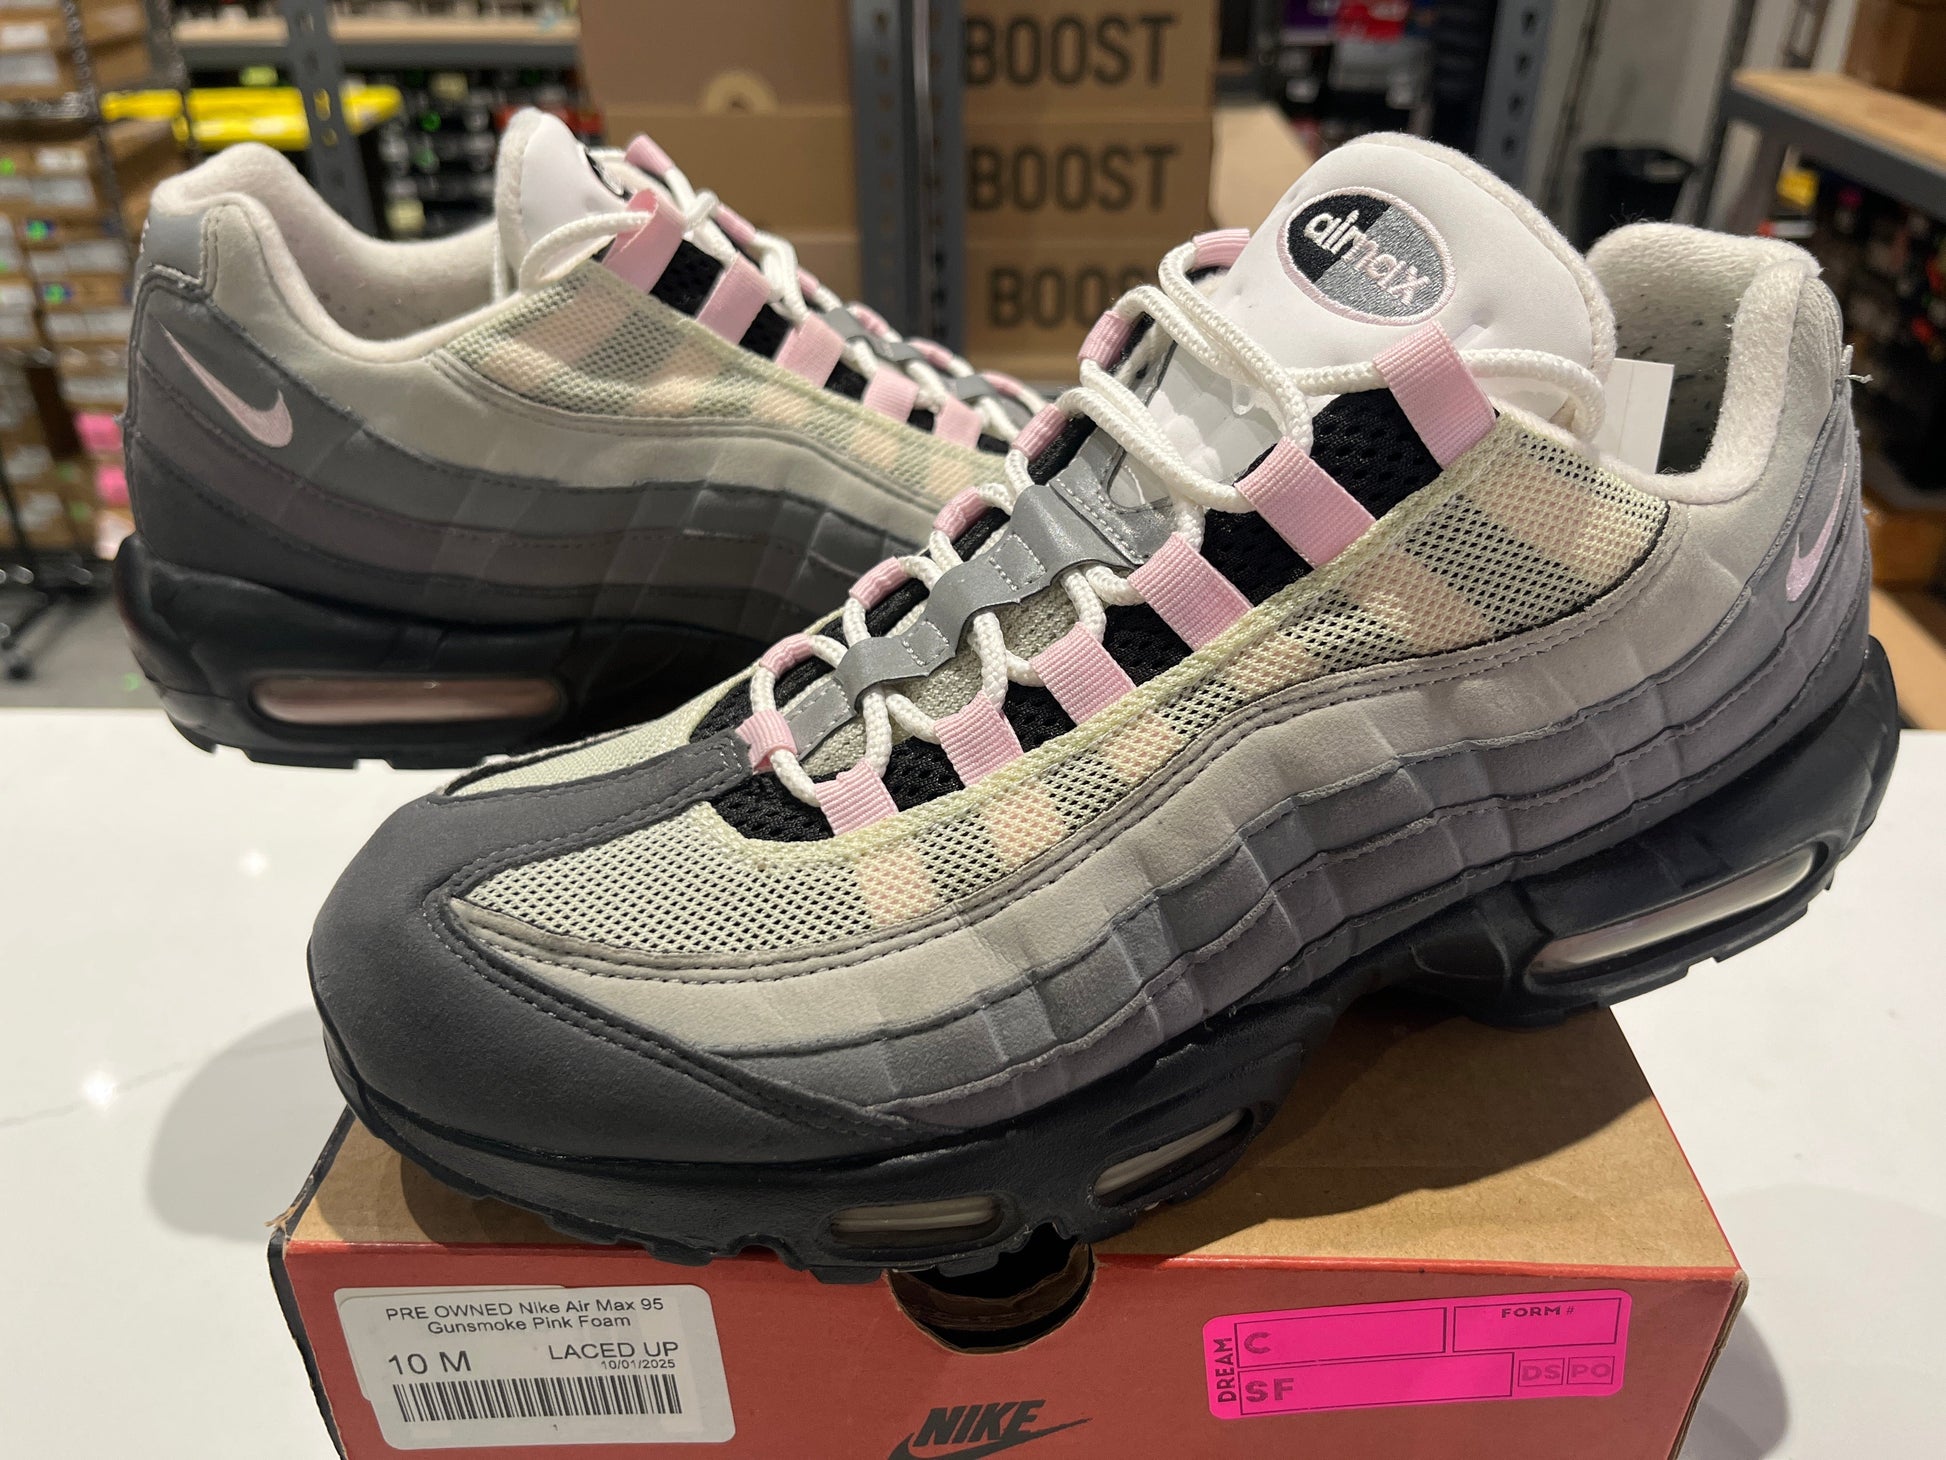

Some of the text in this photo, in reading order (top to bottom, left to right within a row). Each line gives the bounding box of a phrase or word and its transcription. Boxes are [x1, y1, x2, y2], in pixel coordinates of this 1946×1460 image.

[963, 14, 1178, 87] BOOST
[968, 144, 1178, 213] BOOST
[386, 1298, 664, 1321] PRE OWNED Nike Air Max 95
[1501, 1305, 1575, 1319] FORM #
[428, 1315, 631, 1334] Gunsmoke Pink Foam
[548, 1341, 679, 1360] LACED UP
[1244, 1331, 1271, 1354] C
[388, 1350, 471, 1375] 10 M
[601, 1358, 676, 1370] 10/01/2025
[1213, 1337, 1237, 1403] DREAM
[1521, 1364, 1562, 1381] DS
[912, 1399, 1046, 1447] NIKE
